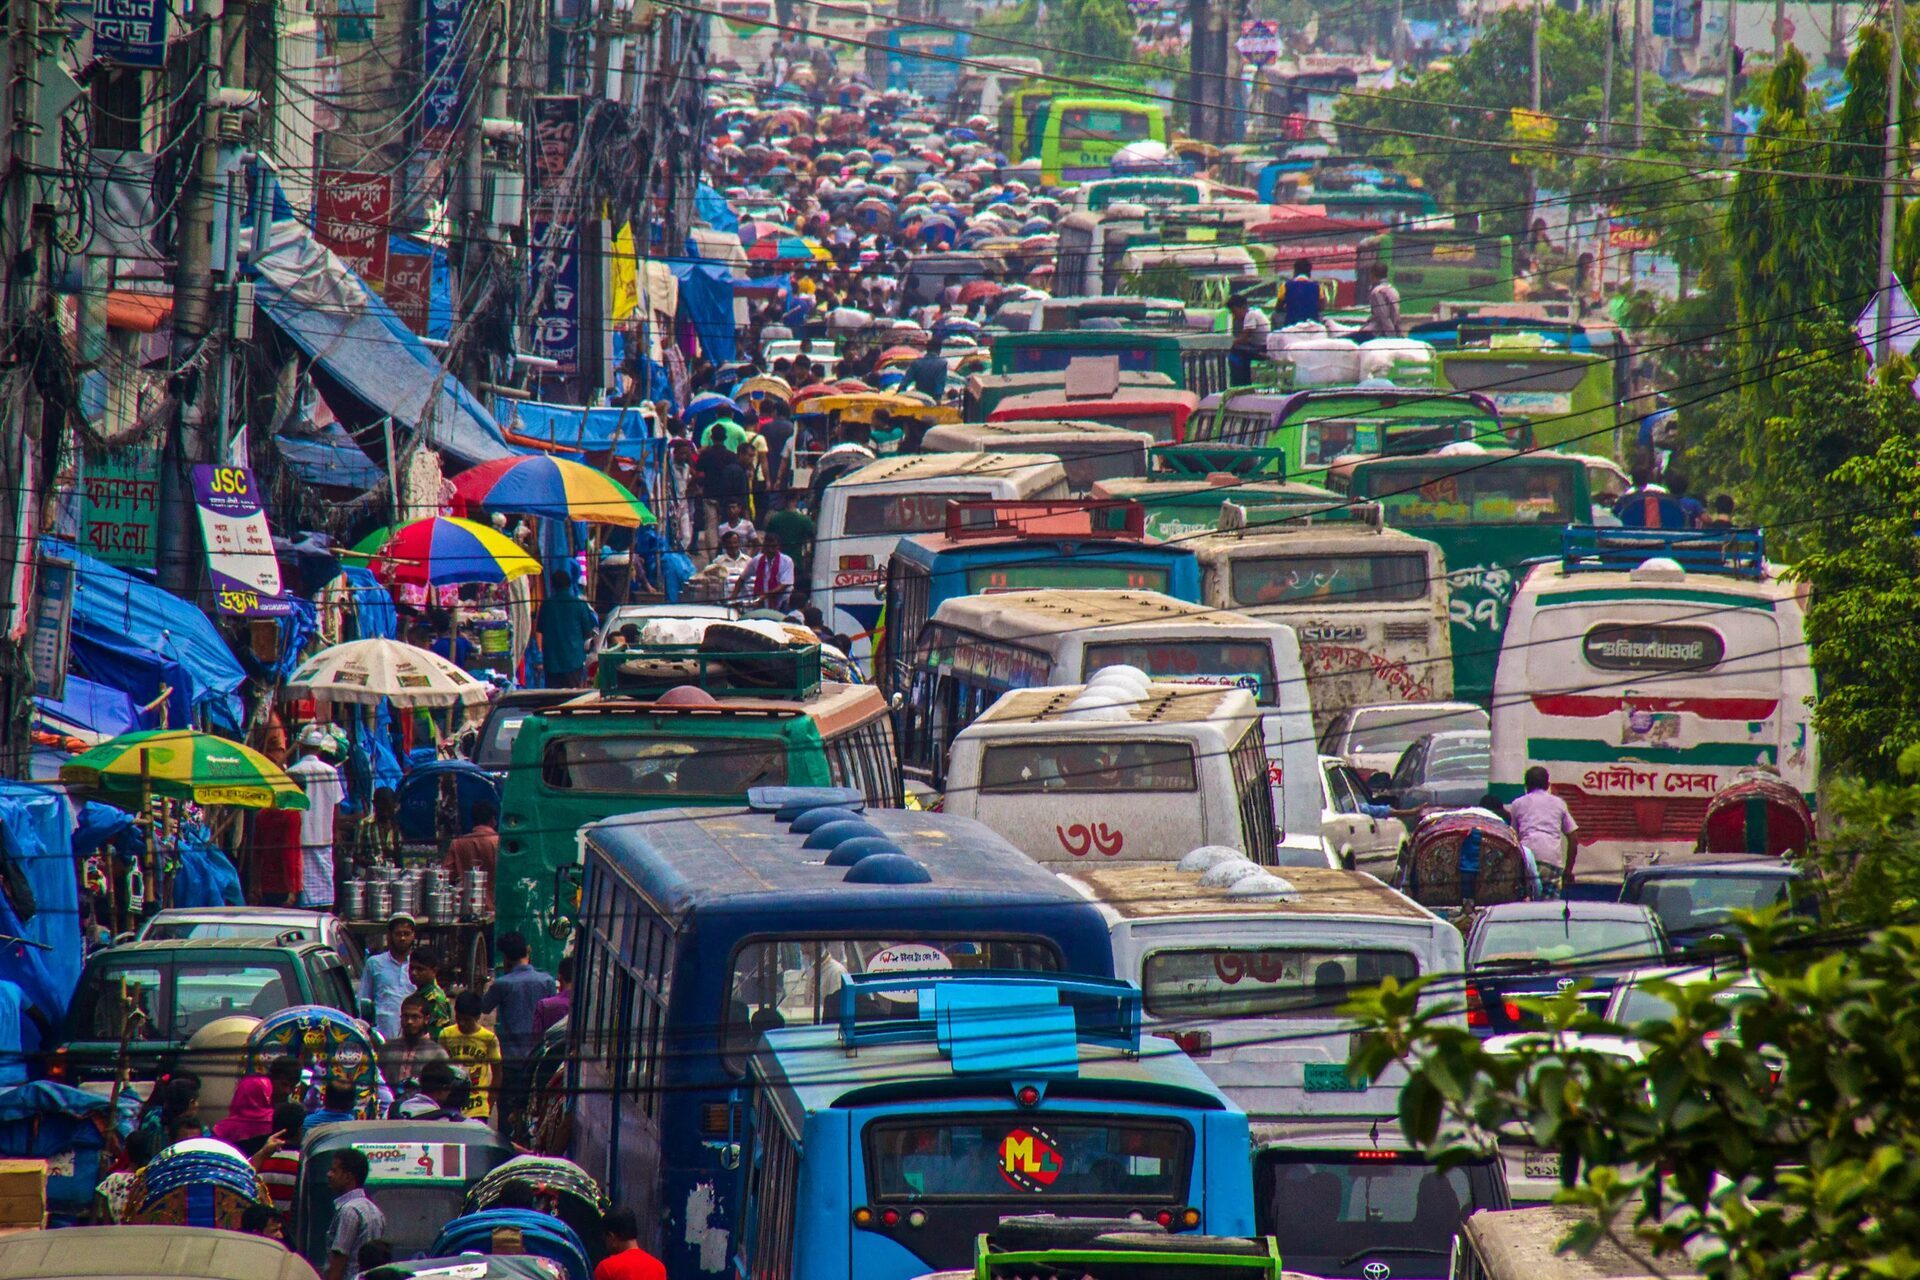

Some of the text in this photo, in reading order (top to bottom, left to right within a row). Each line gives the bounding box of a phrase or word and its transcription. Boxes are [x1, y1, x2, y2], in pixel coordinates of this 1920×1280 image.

[84, 477, 159, 512] ফ্যাশন
[211, 467, 247, 495] JSC
[87, 520, 150, 554] বাংলা
[219, 584, 259, 614] উদ্ভাস
[1449, 599, 1500, 632] ২৭
[1300, 624, 1366, 643] ISUZU
[1582, 766, 1719, 793] গ্রামীণ সেবা
[1056, 822, 1124, 857] ৩৬
